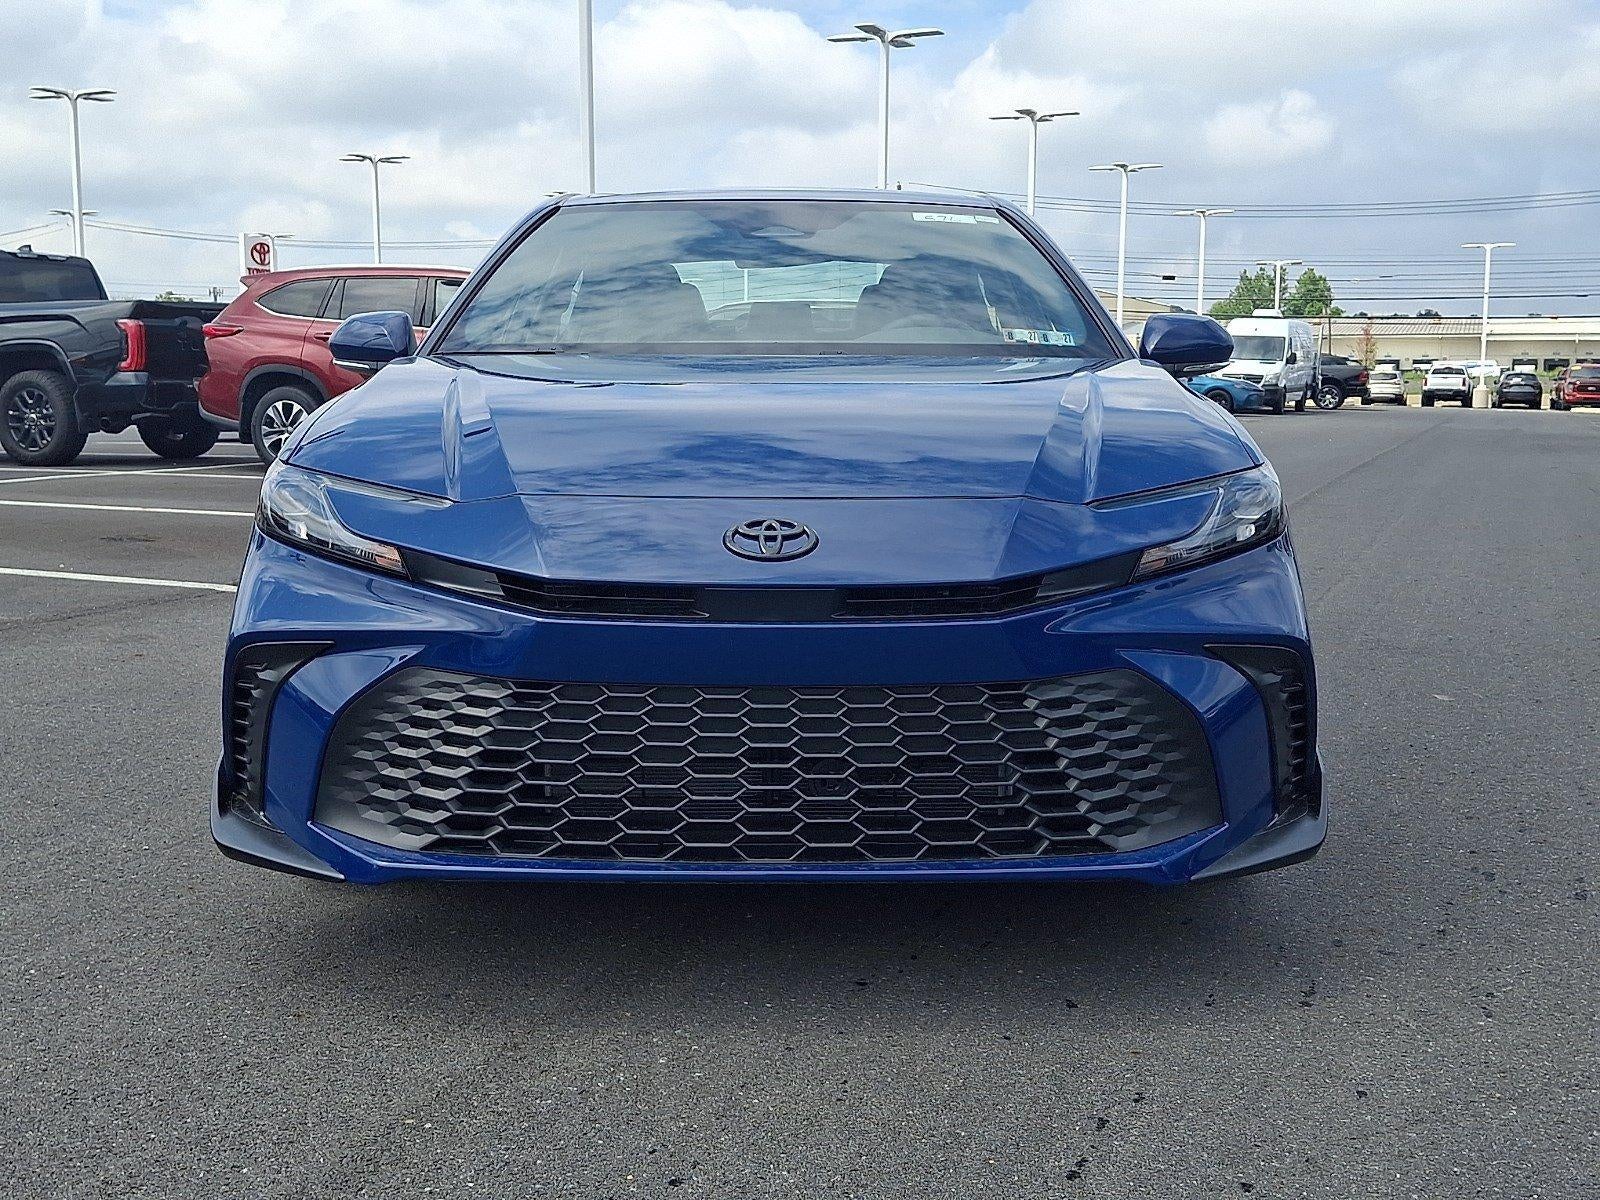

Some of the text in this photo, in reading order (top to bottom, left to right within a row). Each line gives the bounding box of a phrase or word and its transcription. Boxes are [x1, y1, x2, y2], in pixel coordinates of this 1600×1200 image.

[246, 267, 270, 275] TOYO
[1007, 331, 1037, 341] 8 27
[1042, 333, 1072, 344] 8 27
